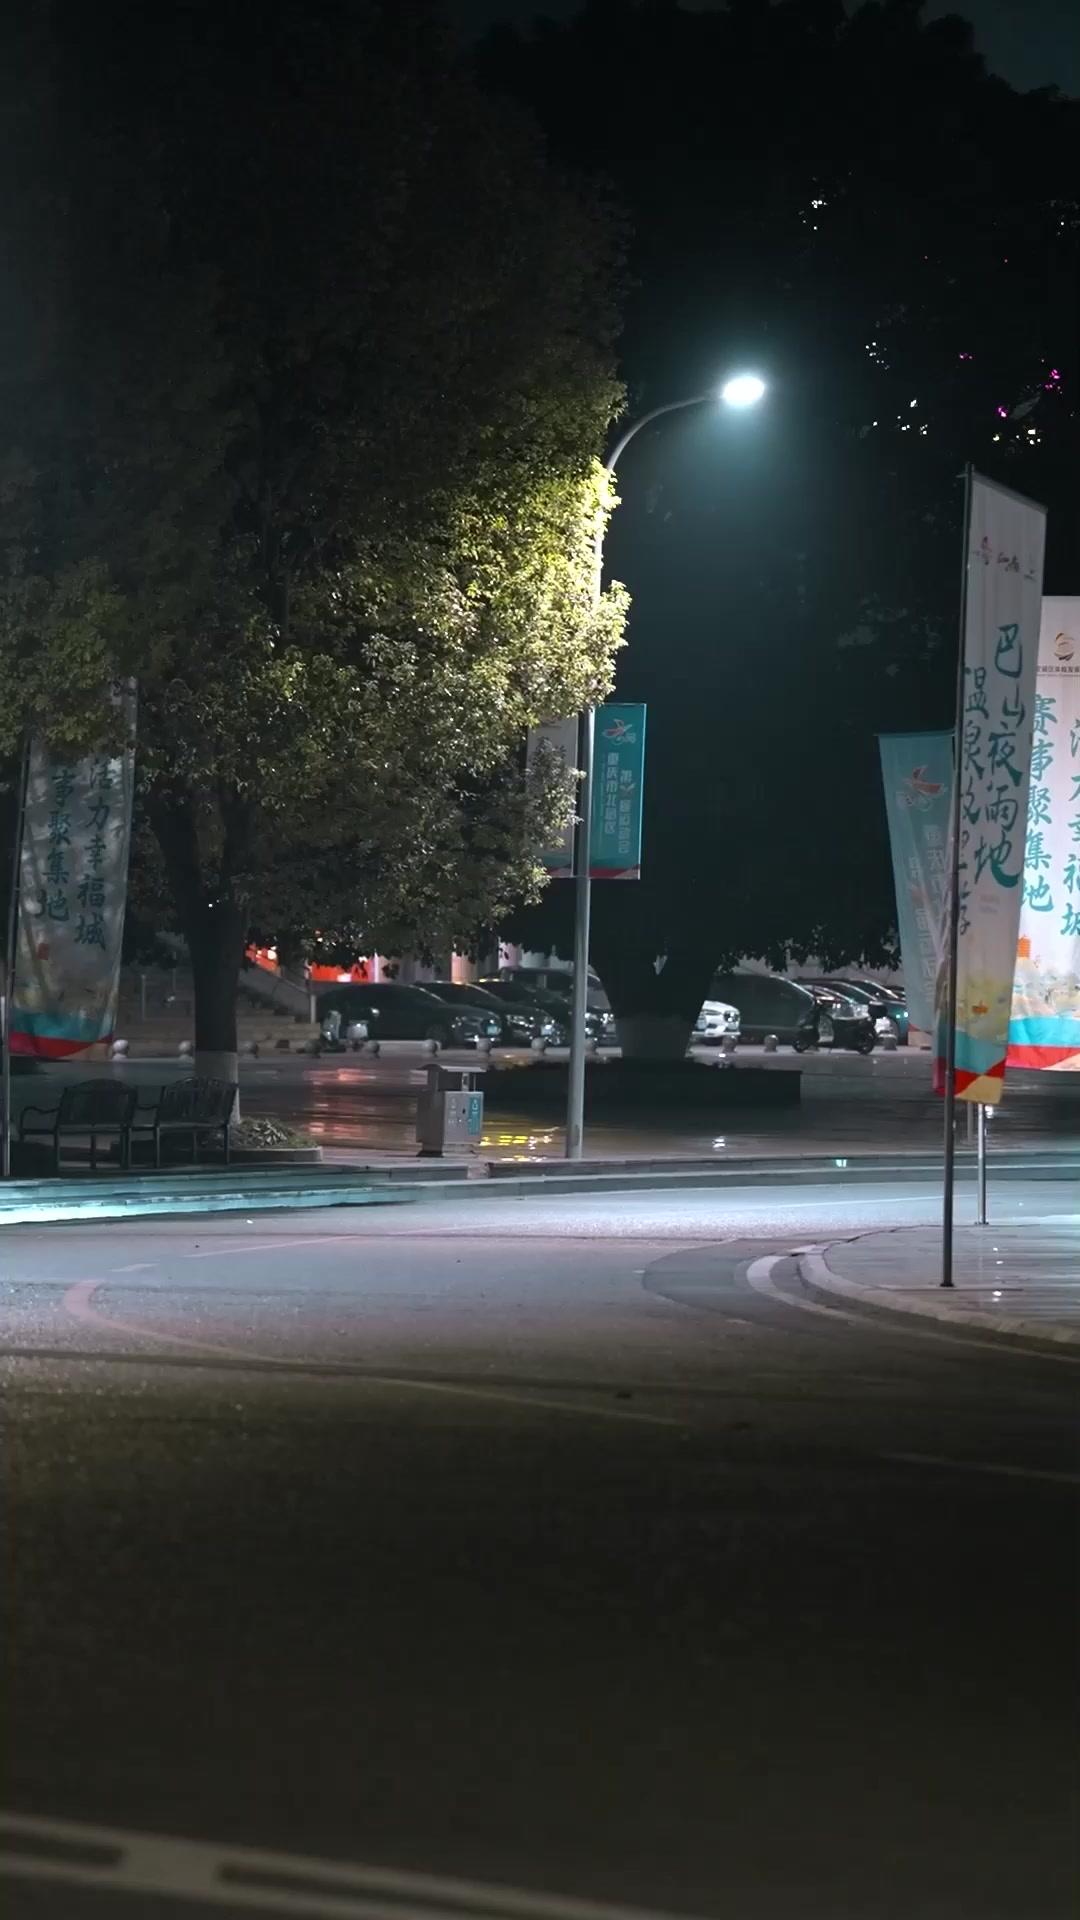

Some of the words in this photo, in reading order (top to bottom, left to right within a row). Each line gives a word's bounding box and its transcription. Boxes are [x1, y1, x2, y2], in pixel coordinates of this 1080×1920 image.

[34, 767, 77, 922] 事聚集地
[975, 623, 1025, 888] 巴山夜雨地
